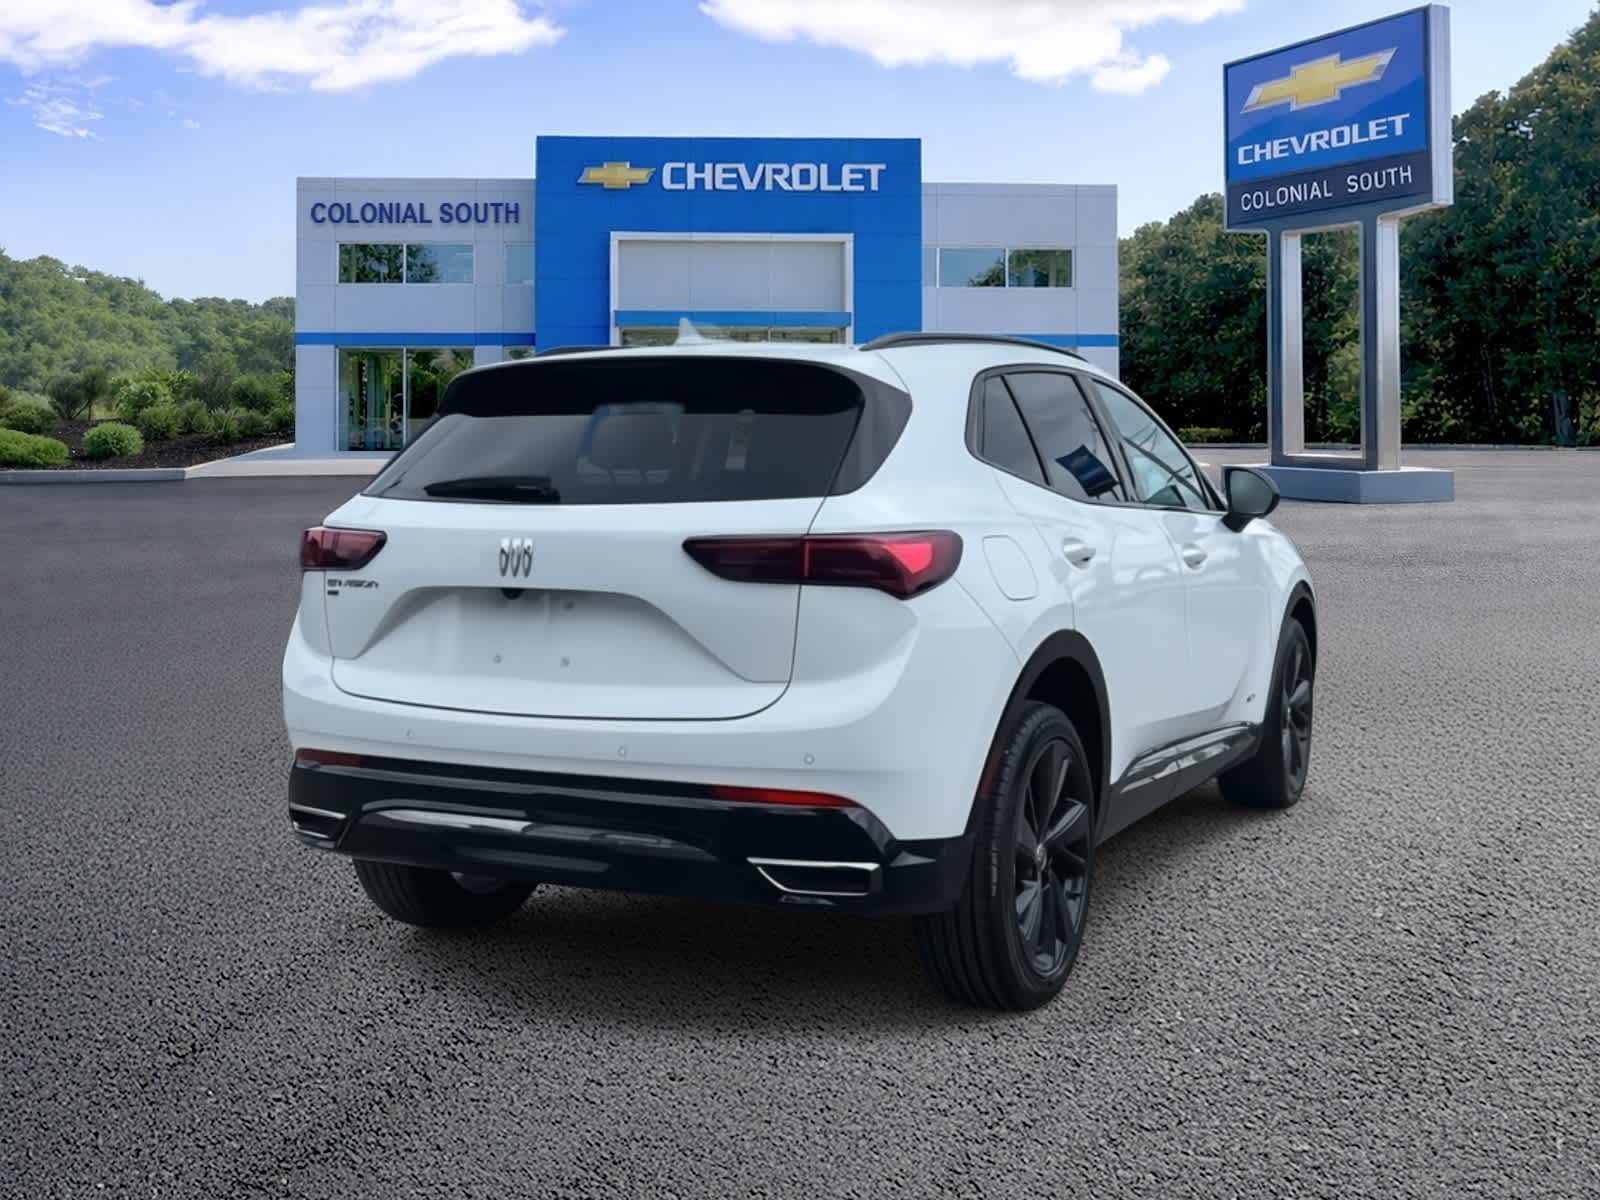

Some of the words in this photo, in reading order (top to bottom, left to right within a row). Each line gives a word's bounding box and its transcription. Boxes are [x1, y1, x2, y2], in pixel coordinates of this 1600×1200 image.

[1238, 113, 1410, 165] CHEVROLET
[662, 161, 887, 192] CHEVROLET
[1240, 180, 1333, 212] COLONIAL
[1346, 165, 1413, 194] SOUTH
[310, 202, 433, 224] COLONIAL
[439, 202, 520, 224] SOUTH
